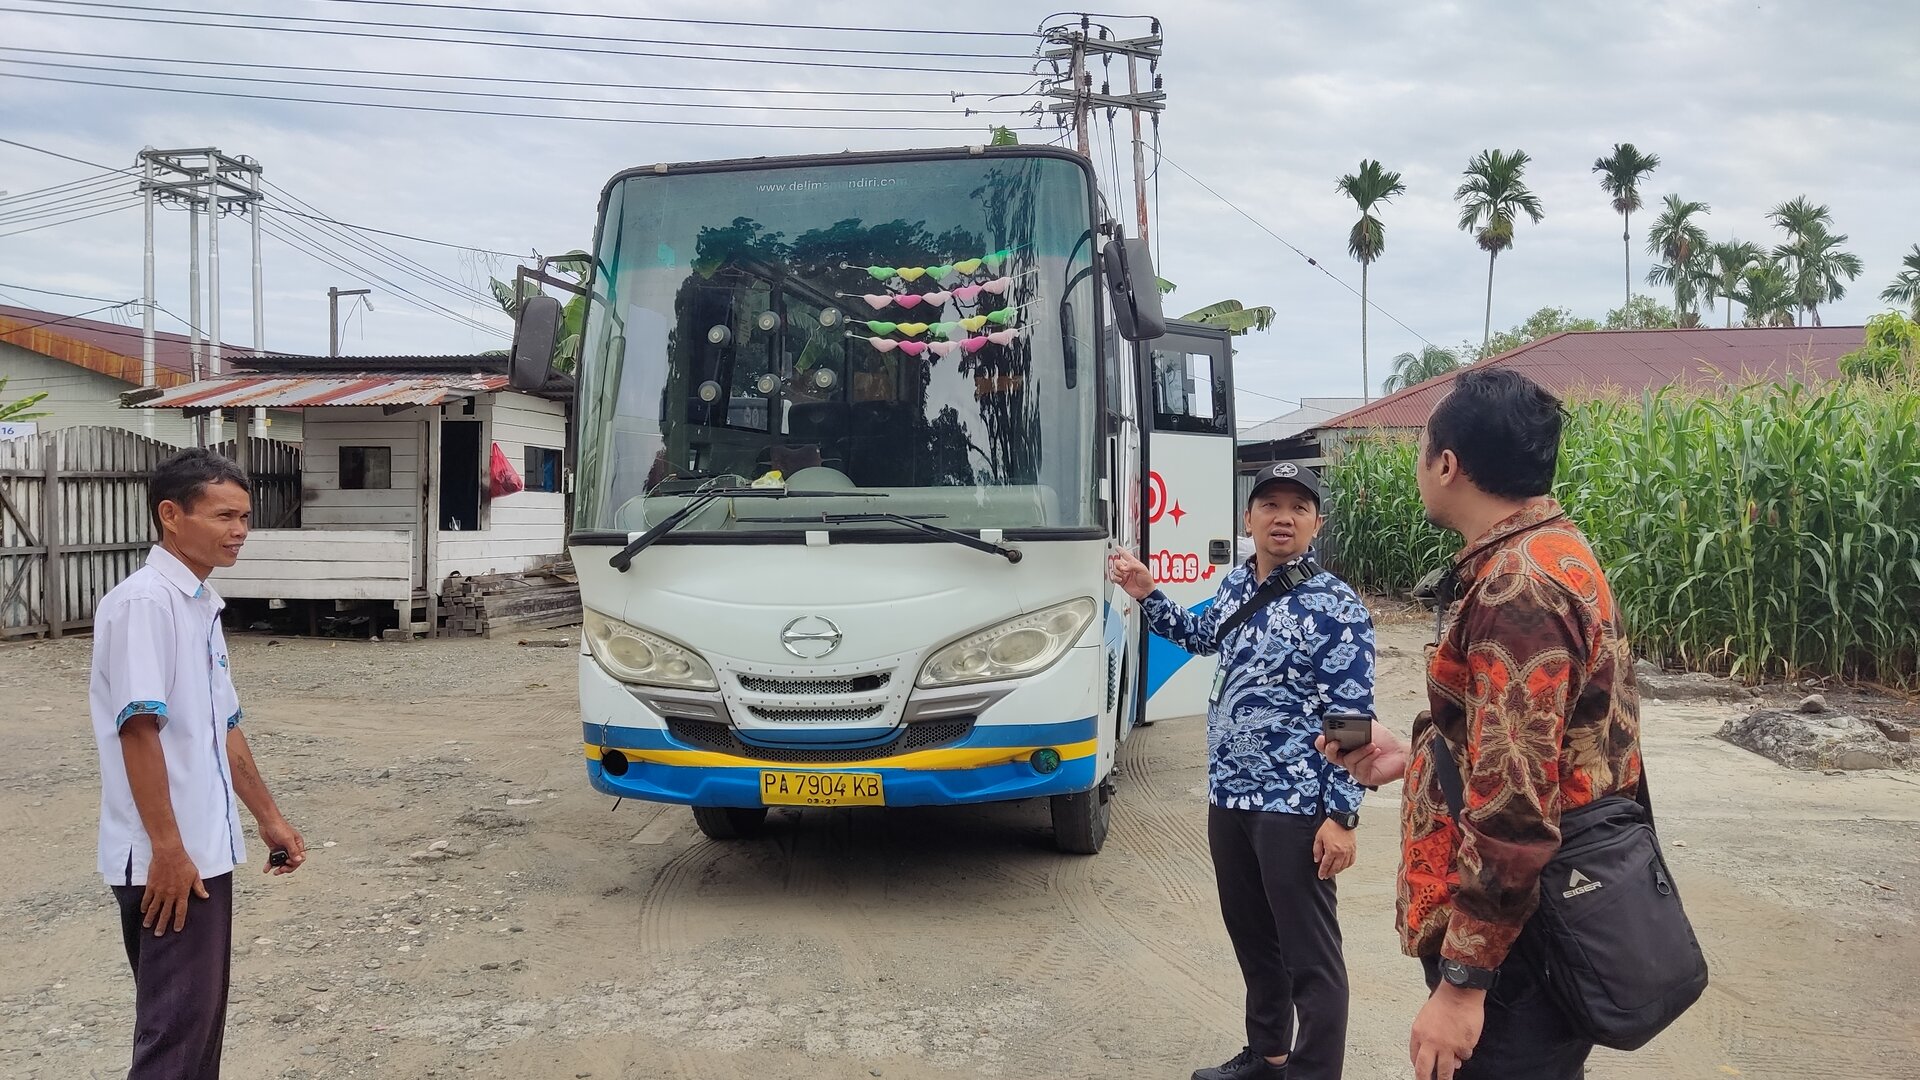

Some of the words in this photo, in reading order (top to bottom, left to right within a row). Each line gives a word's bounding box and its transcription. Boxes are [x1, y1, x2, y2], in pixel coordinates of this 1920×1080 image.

[764, 773, 789, 795] PA
[795, 774, 846, 797] 7904
[853, 776, 879, 797] KB
[1562, 881, 1603, 899] EIGER
